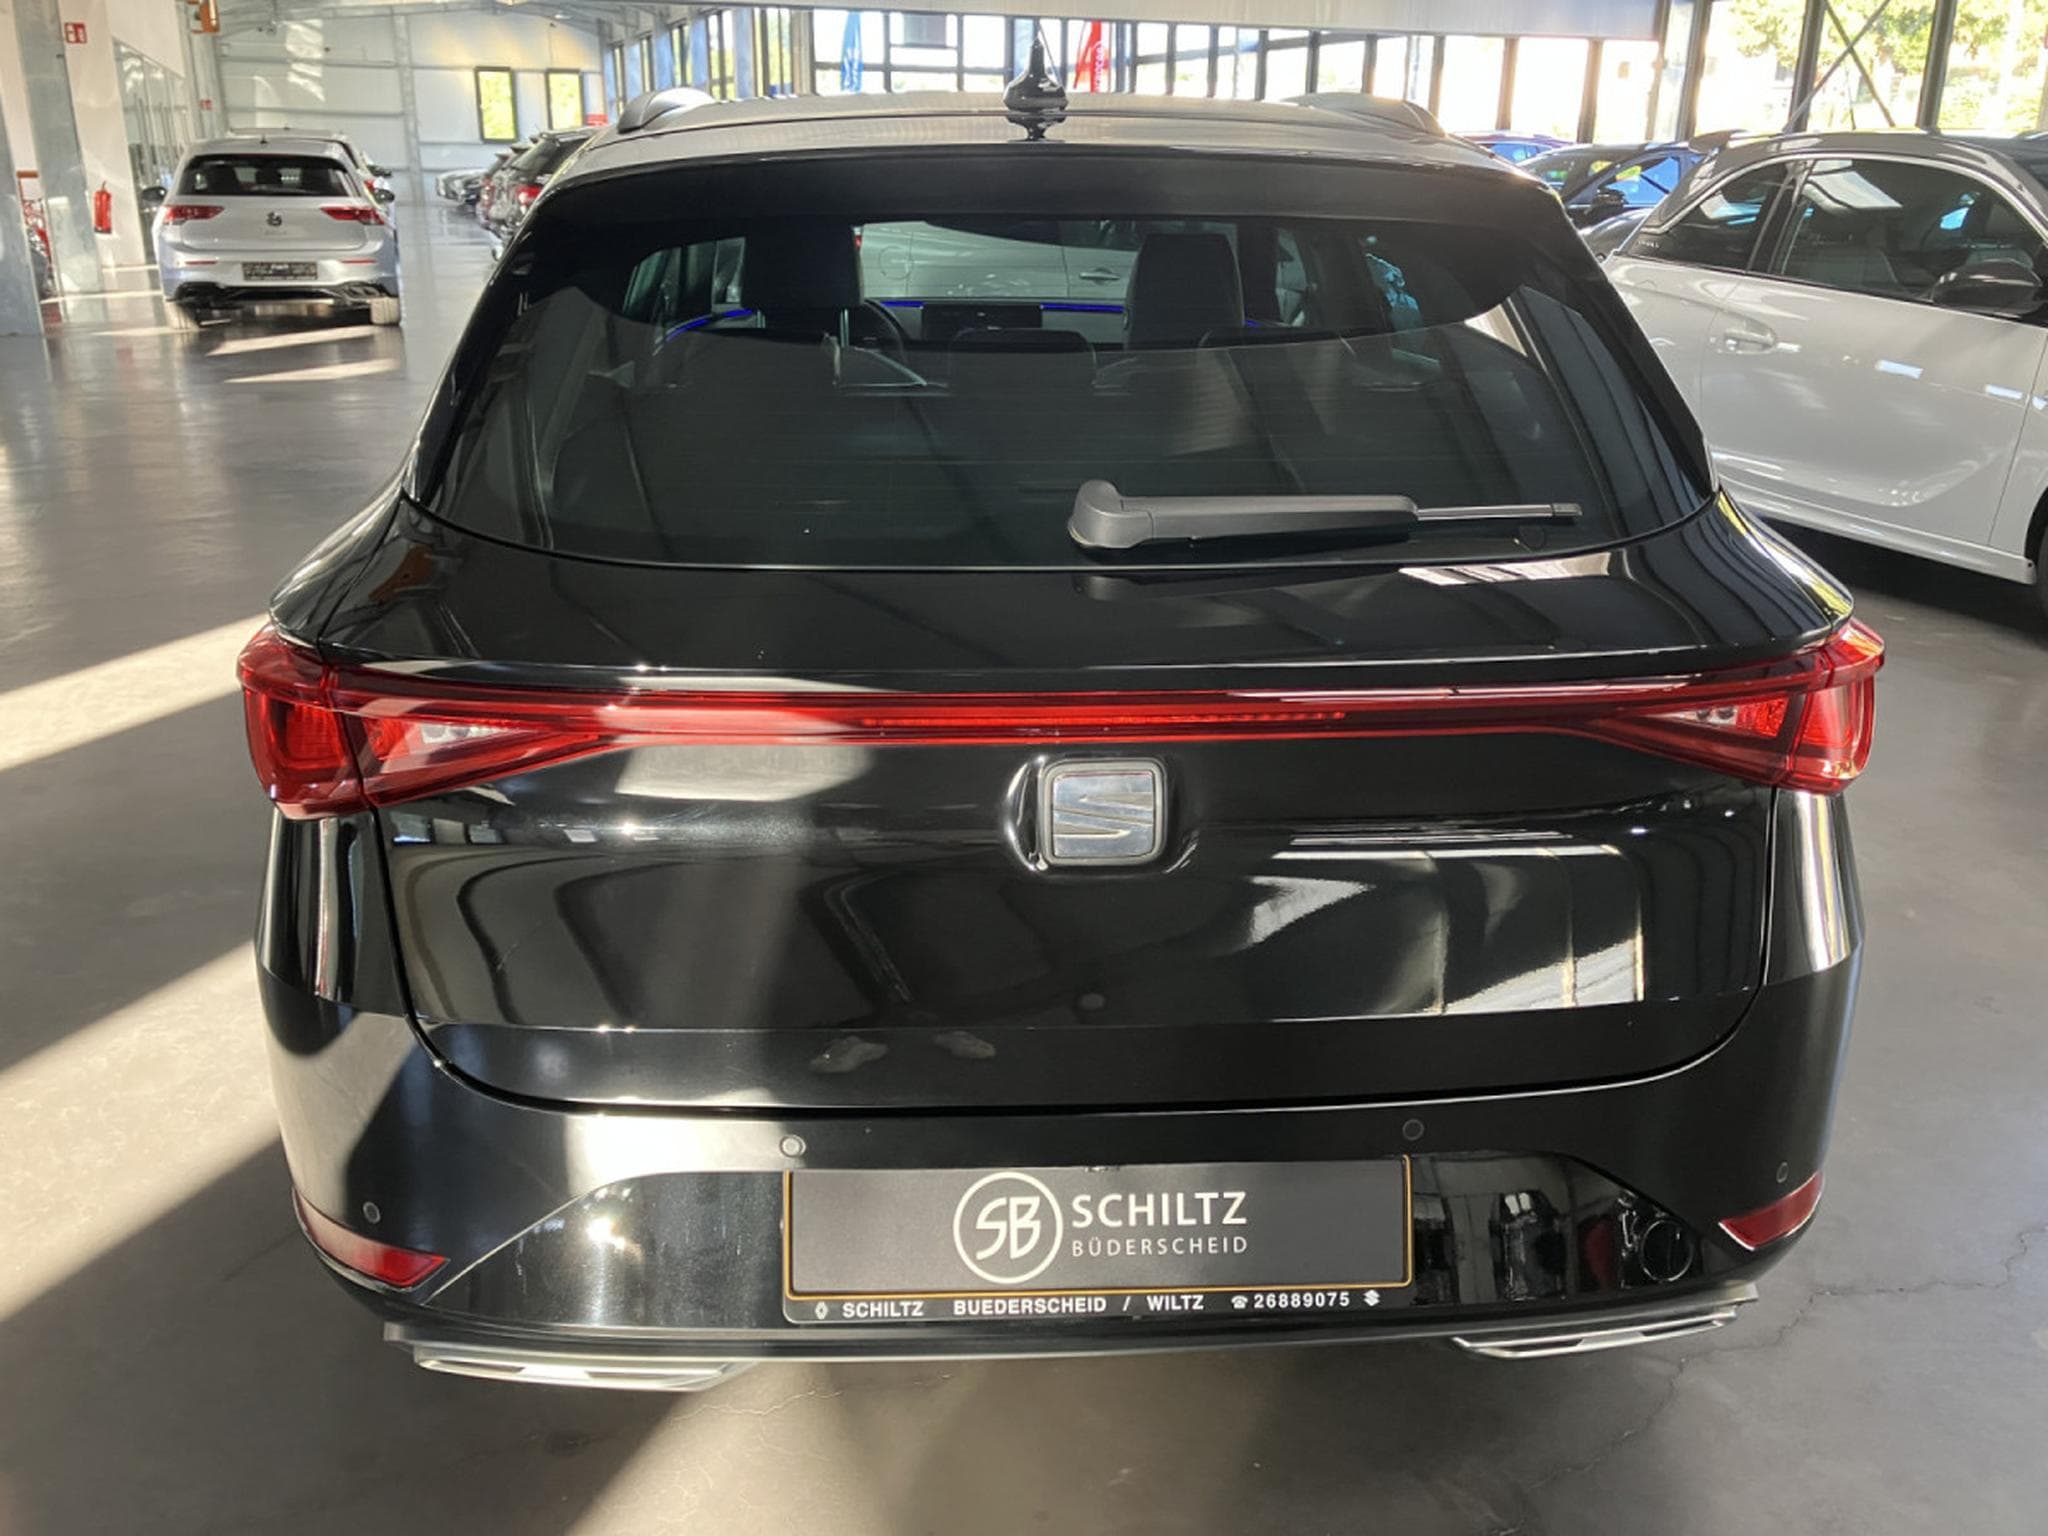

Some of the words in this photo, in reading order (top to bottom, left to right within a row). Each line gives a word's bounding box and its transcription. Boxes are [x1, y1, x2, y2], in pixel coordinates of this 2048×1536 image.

[1072, 1191, 1247, 1228] SCHILTZ
[976, 1196, 1041, 1260] SB
[1072, 1236, 1248, 1257] BÜDERSCHEID
[842, 1301, 925, 1318] SCHILTZ
[953, 1297, 1107, 1315] BUEDERSCHEID
[1122, 1296, 1131, 1311] /
[1146, 1295, 1204, 1311] WILTZ
[1254, 1292, 1350, 1308] 26889075
